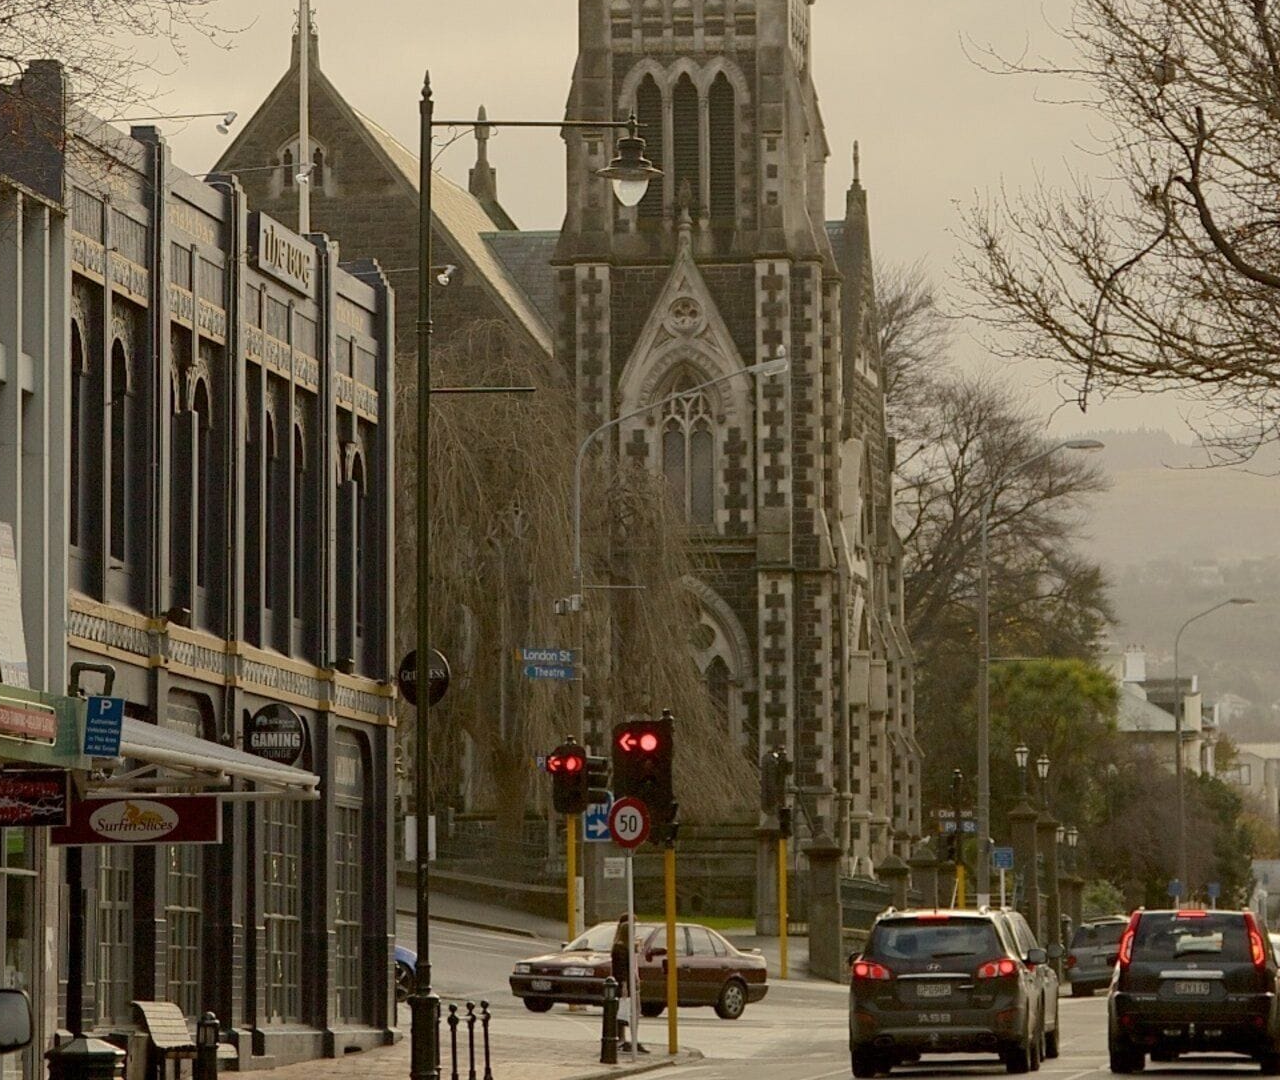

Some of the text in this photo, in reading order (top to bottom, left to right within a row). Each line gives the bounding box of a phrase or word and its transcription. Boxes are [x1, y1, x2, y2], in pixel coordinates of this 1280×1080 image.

[523, 648, 572, 662] London St
[535, 667, 566, 679] Theatre
[100, 699, 113, 715] P
[251, 733, 301, 748] GAMING
[137, 818, 174, 832] Slices
[619, 815, 638, 833] 50
